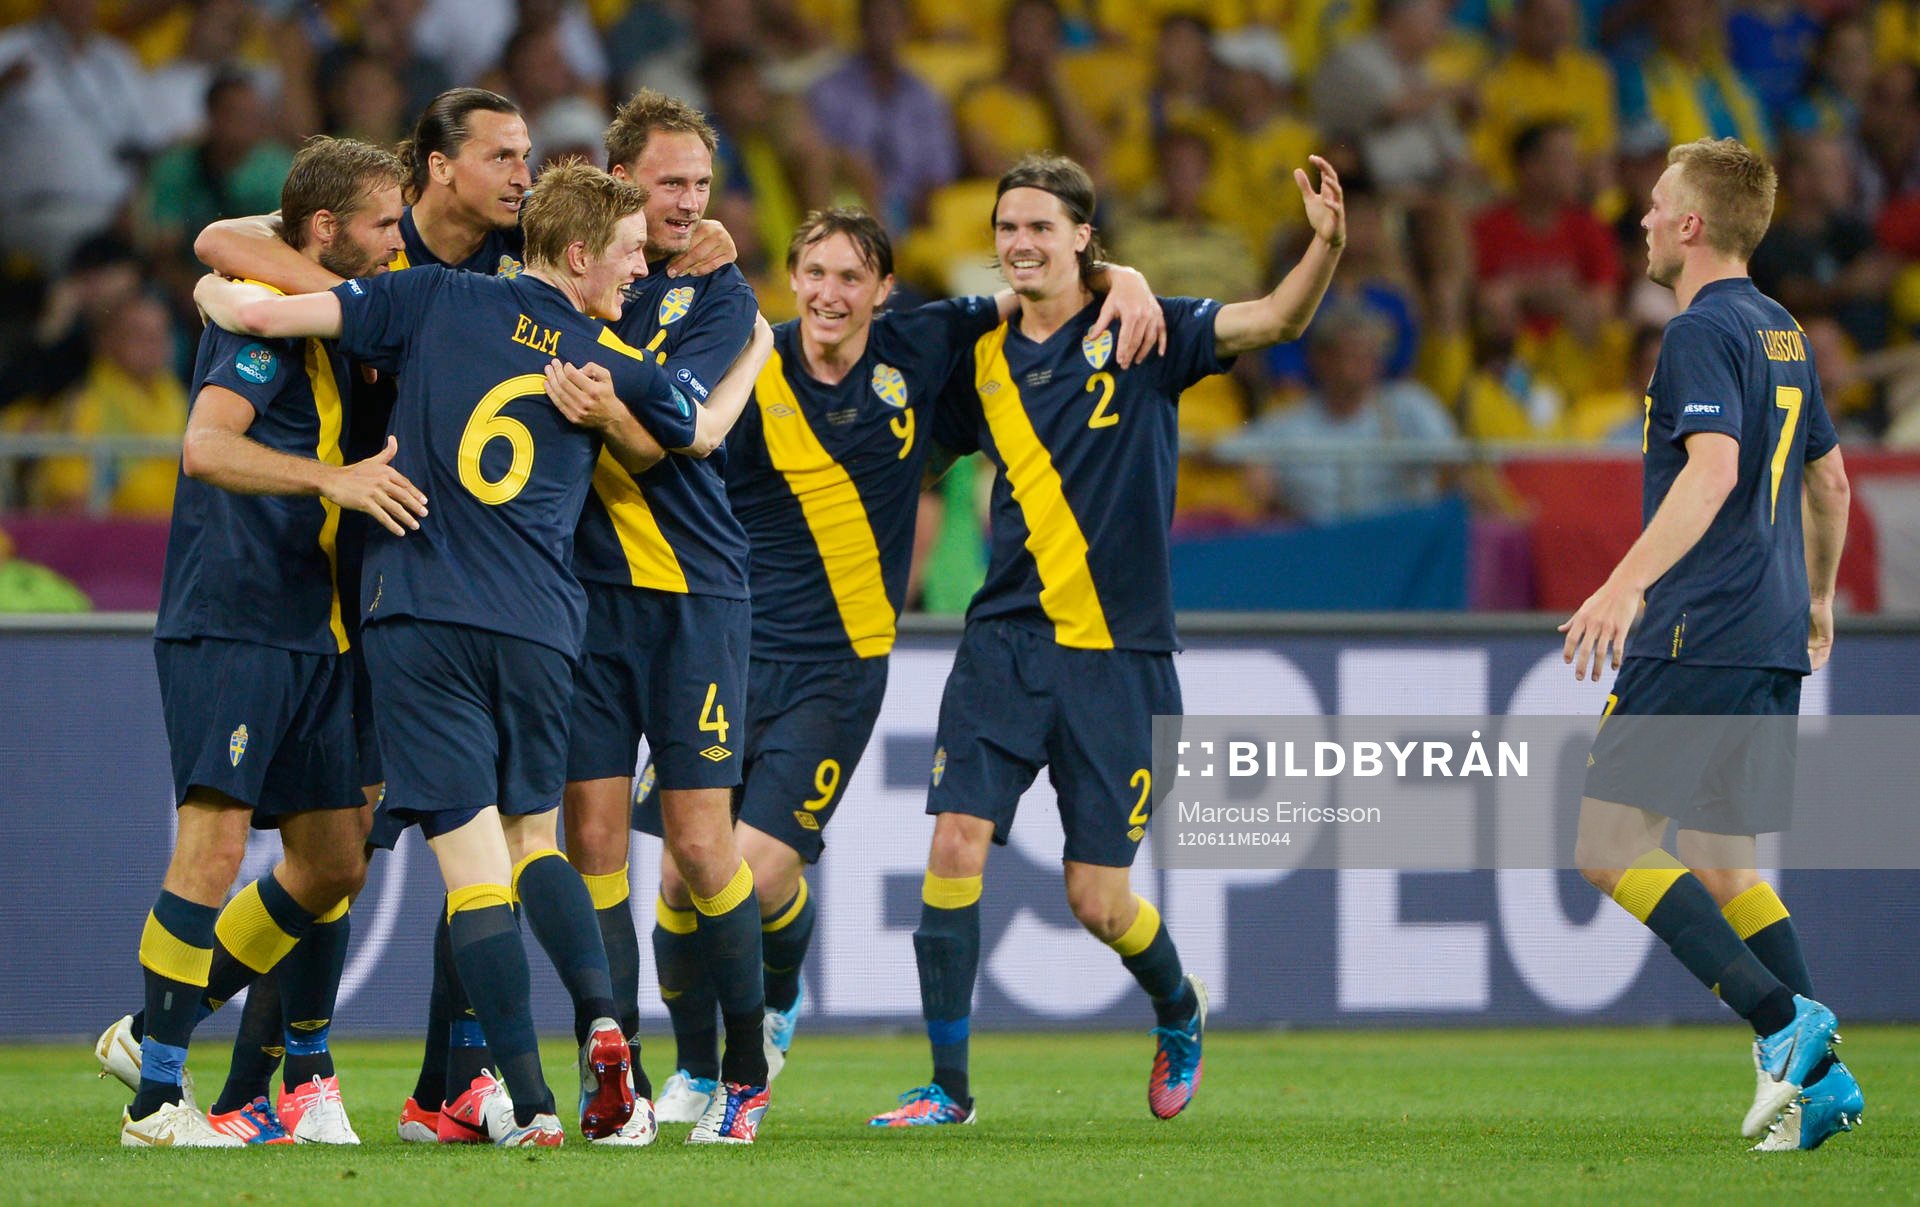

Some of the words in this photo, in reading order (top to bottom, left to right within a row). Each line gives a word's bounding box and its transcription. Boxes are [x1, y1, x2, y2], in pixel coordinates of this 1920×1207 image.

[511, 313, 562, 357] ELM
[1086, 371, 1120, 429] 2
[457, 373, 548, 506] 6
[1770, 385, 1803, 525] 7
[698, 682, 730, 743] 4
[803, 758, 841, 811] 9
[1128, 767, 1152, 827] 2
